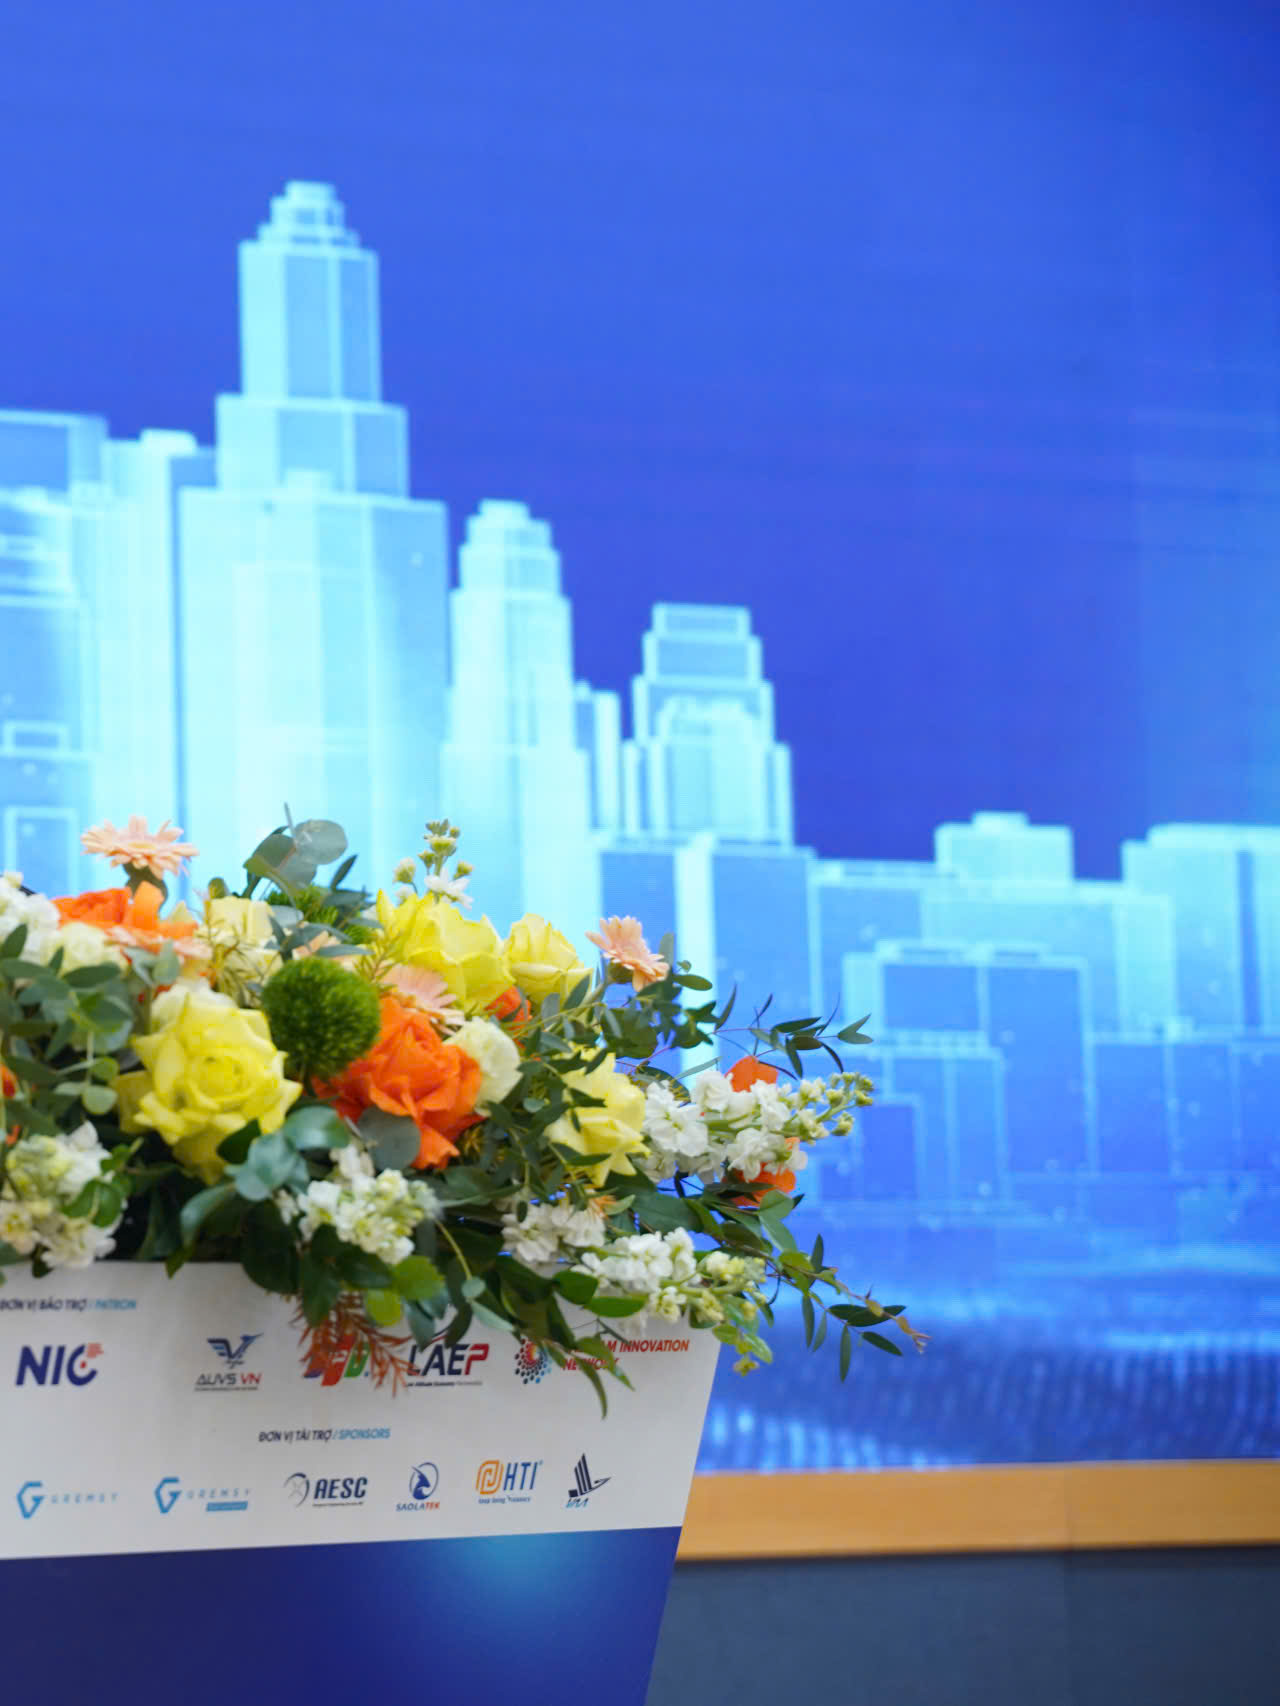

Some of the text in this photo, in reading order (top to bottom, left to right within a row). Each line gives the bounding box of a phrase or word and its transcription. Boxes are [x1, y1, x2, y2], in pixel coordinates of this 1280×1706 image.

[619, 1339, 690, 1353] INNOVATION
[16, 1344, 98, 1386] NIC
[407, 1343, 490, 1377] LAEP
[240, 1372, 263, 1385] VN
[258, 1430, 282, 1442] ĐƠN
[283, 1430, 294, 1444] VỊ
[312, 1428, 333, 1443] TRỢ
[339, 1427, 390, 1441] SPONSORS
[313, 1476, 368, 1500] AESC
[502, 1461, 538, 1491] HTI
